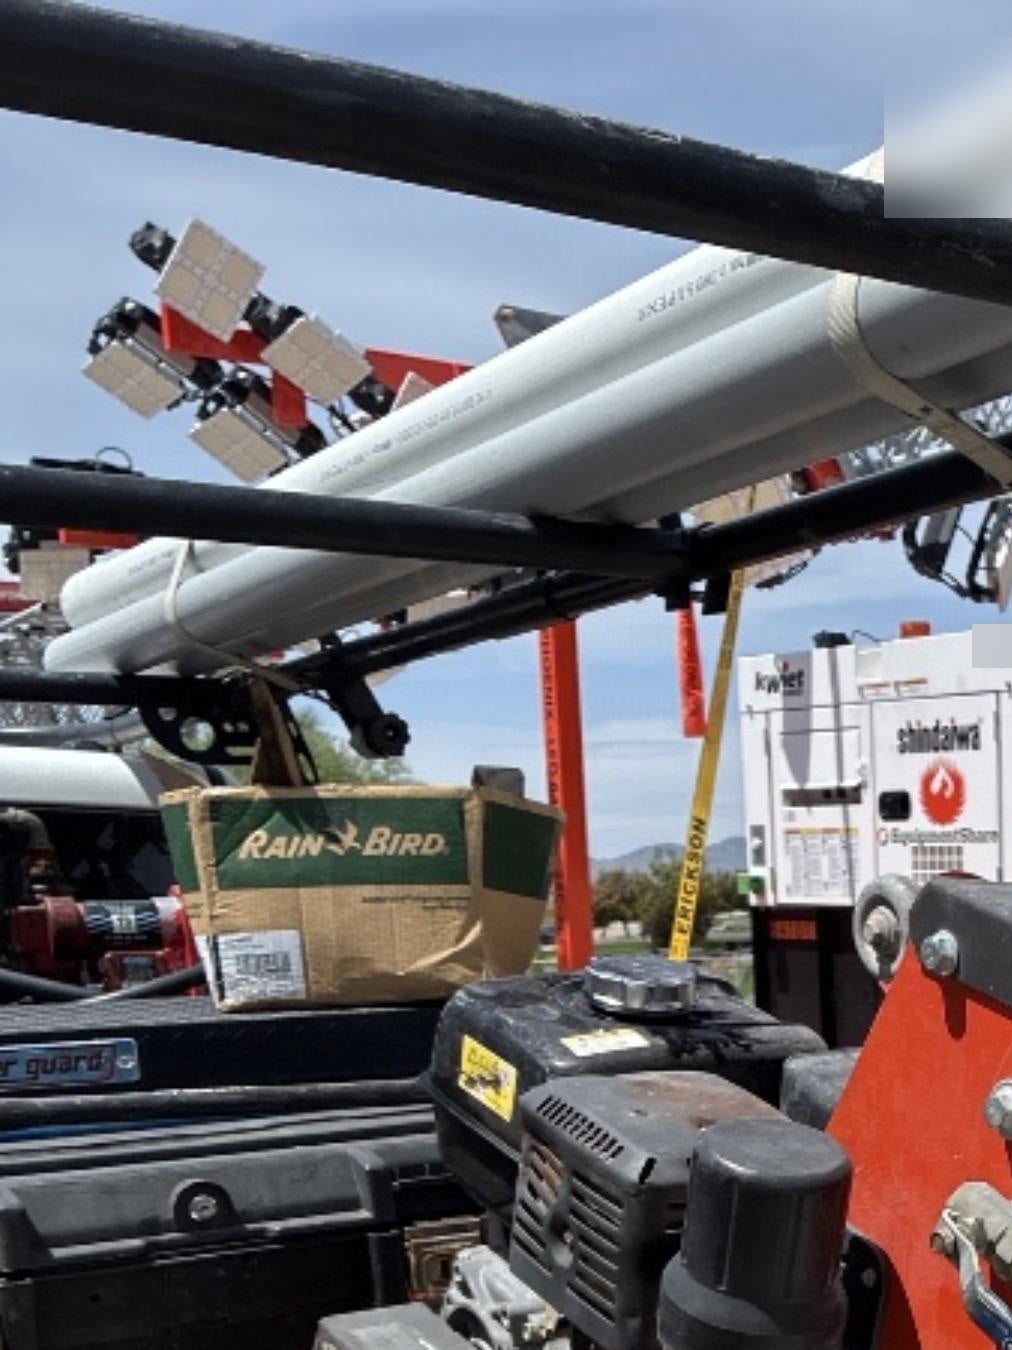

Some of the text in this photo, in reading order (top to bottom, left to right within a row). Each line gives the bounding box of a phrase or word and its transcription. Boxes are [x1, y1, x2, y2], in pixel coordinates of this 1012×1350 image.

[896, 716, 982, 754] shindaiwa
[237, 826, 447, 860] RAIN BIRD
[676, 815, 707, 936] ERICKSON
[26, 1048, 104, 1081] guard
